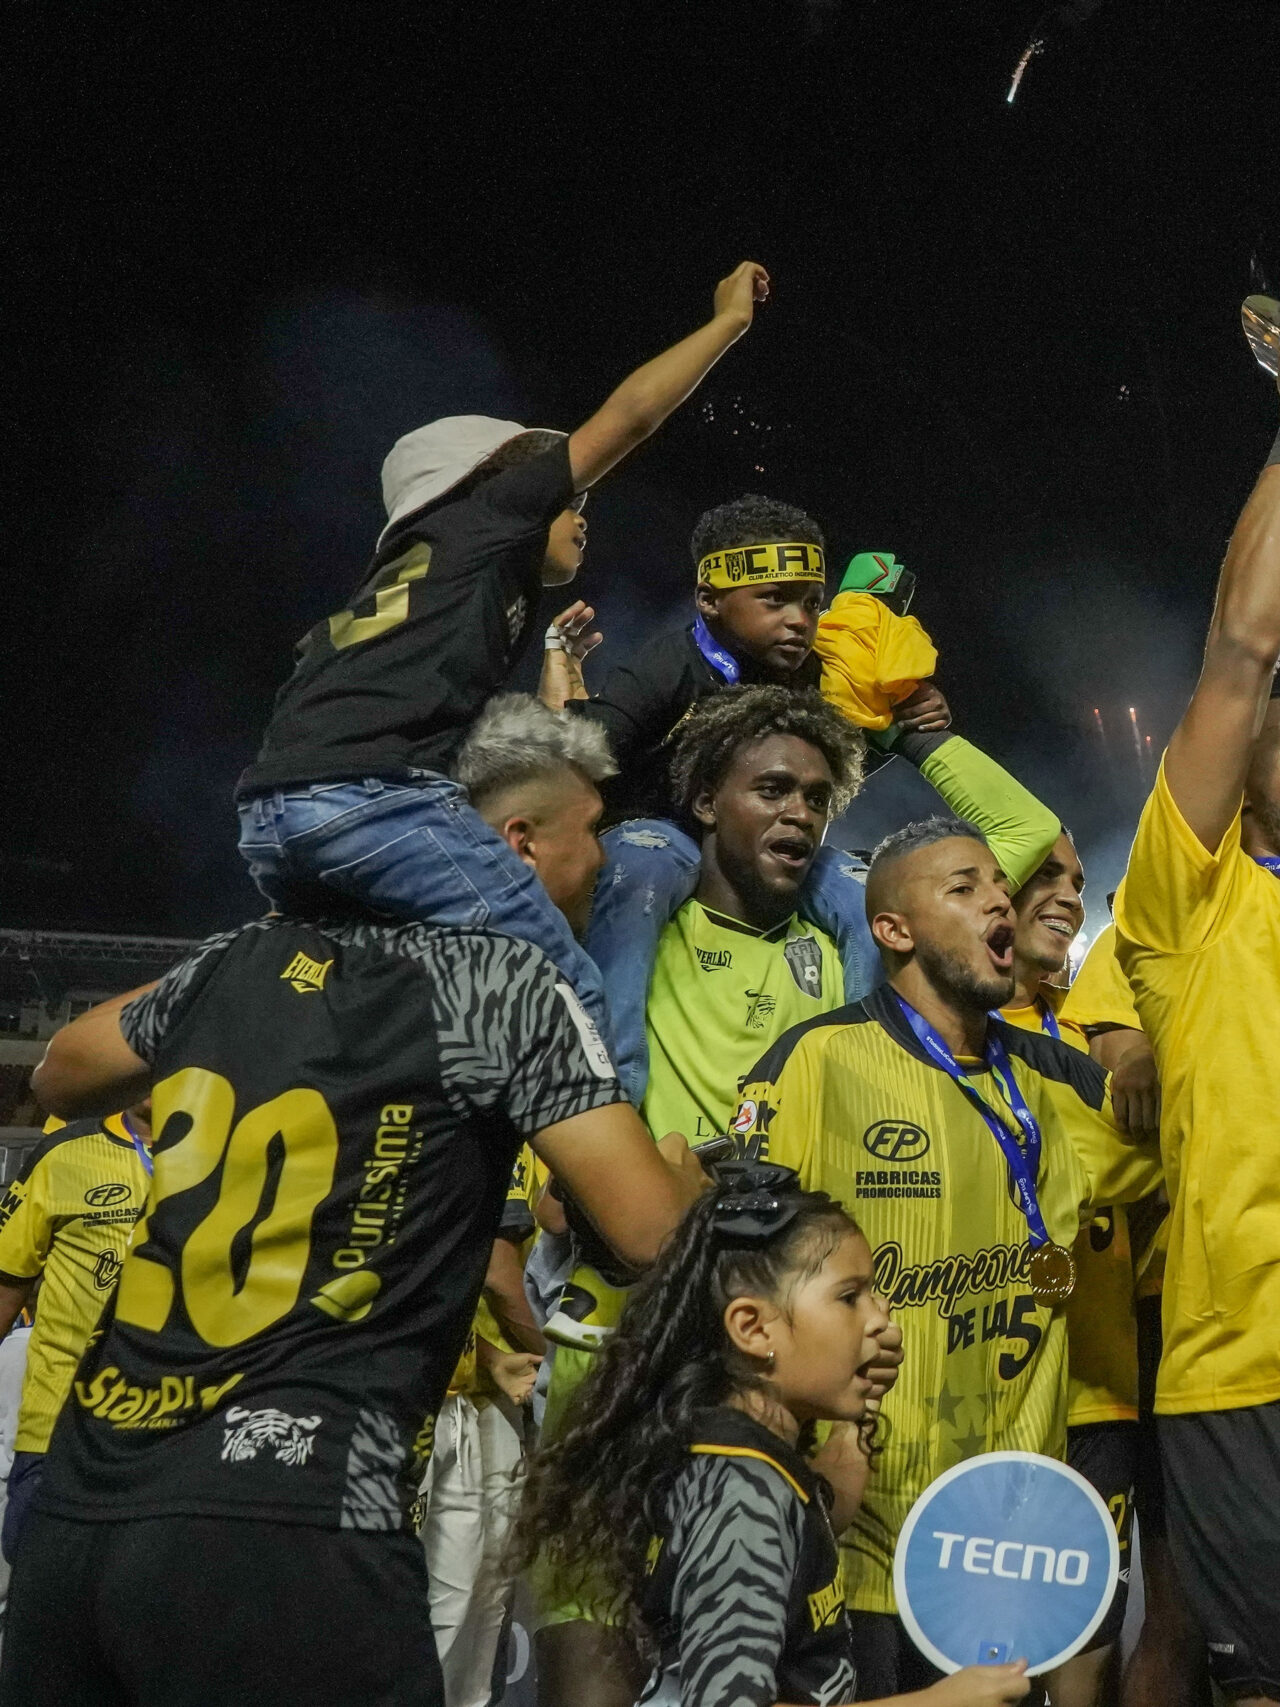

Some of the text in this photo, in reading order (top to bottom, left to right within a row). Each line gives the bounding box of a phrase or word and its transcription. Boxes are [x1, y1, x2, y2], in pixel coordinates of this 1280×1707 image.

[114, 1066, 340, 1348] 20
[856, 1171, 941, 1186] FABRICAS
[856, 1187, 941, 1199] PROMOCIONALES
[871, 1241, 1033, 1319] Campeone
[947, 1294, 1043, 1381] DE LA 5
[932, 1530, 1090, 1586] TECNO
